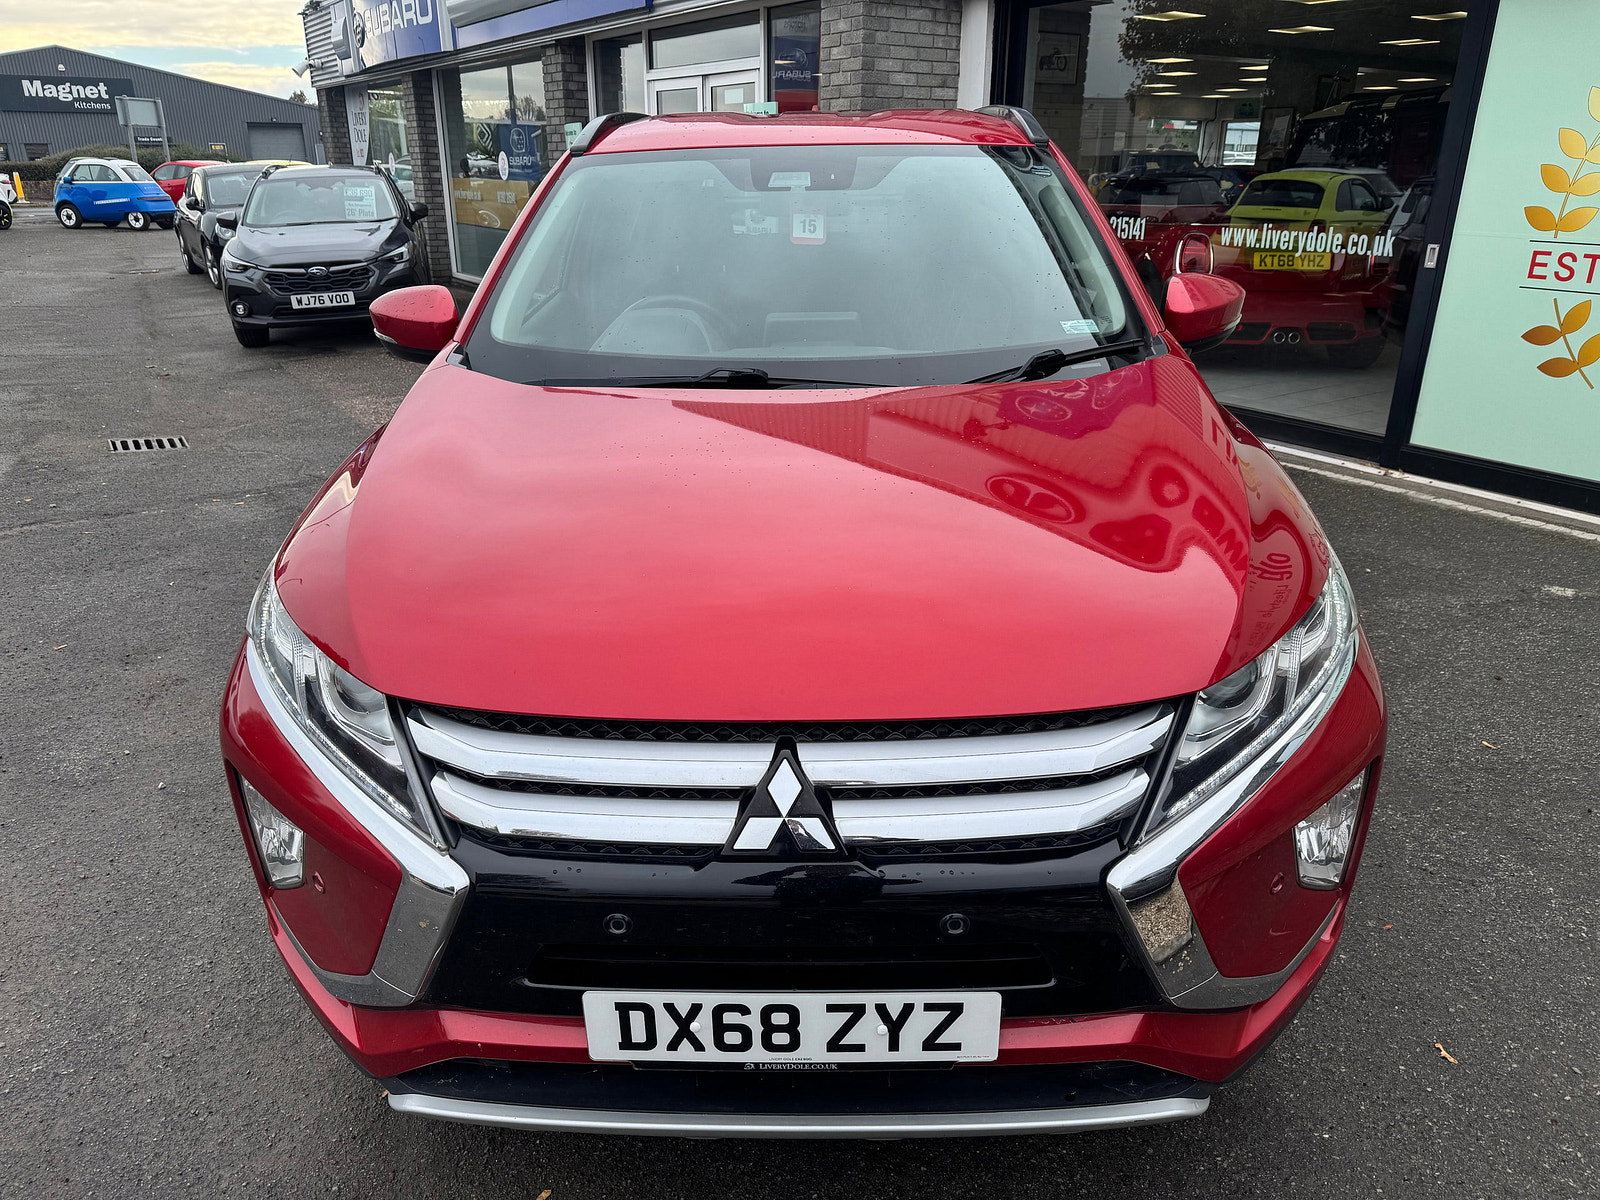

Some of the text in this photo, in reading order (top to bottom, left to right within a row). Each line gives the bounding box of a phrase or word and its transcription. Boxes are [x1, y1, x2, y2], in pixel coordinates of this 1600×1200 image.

[363, 0, 433, 40] SUBARU
[21, 79, 110, 102] Magnet
[74, 101, 111, 110] Kitchens
[509, 156, 532, 166] SUBARU
[801, 219, 817, 234] 15
[1220, 223, 1396, 257] www.liverydole.co.uk
[1259, 254, 1325, 268] KT68 YHZ
[1527, 250, 1600, 284] EST
[295, 293, 350, 306] WJ76 VOO
[614, 1001, 965, 1053] DX68 ZYZ
